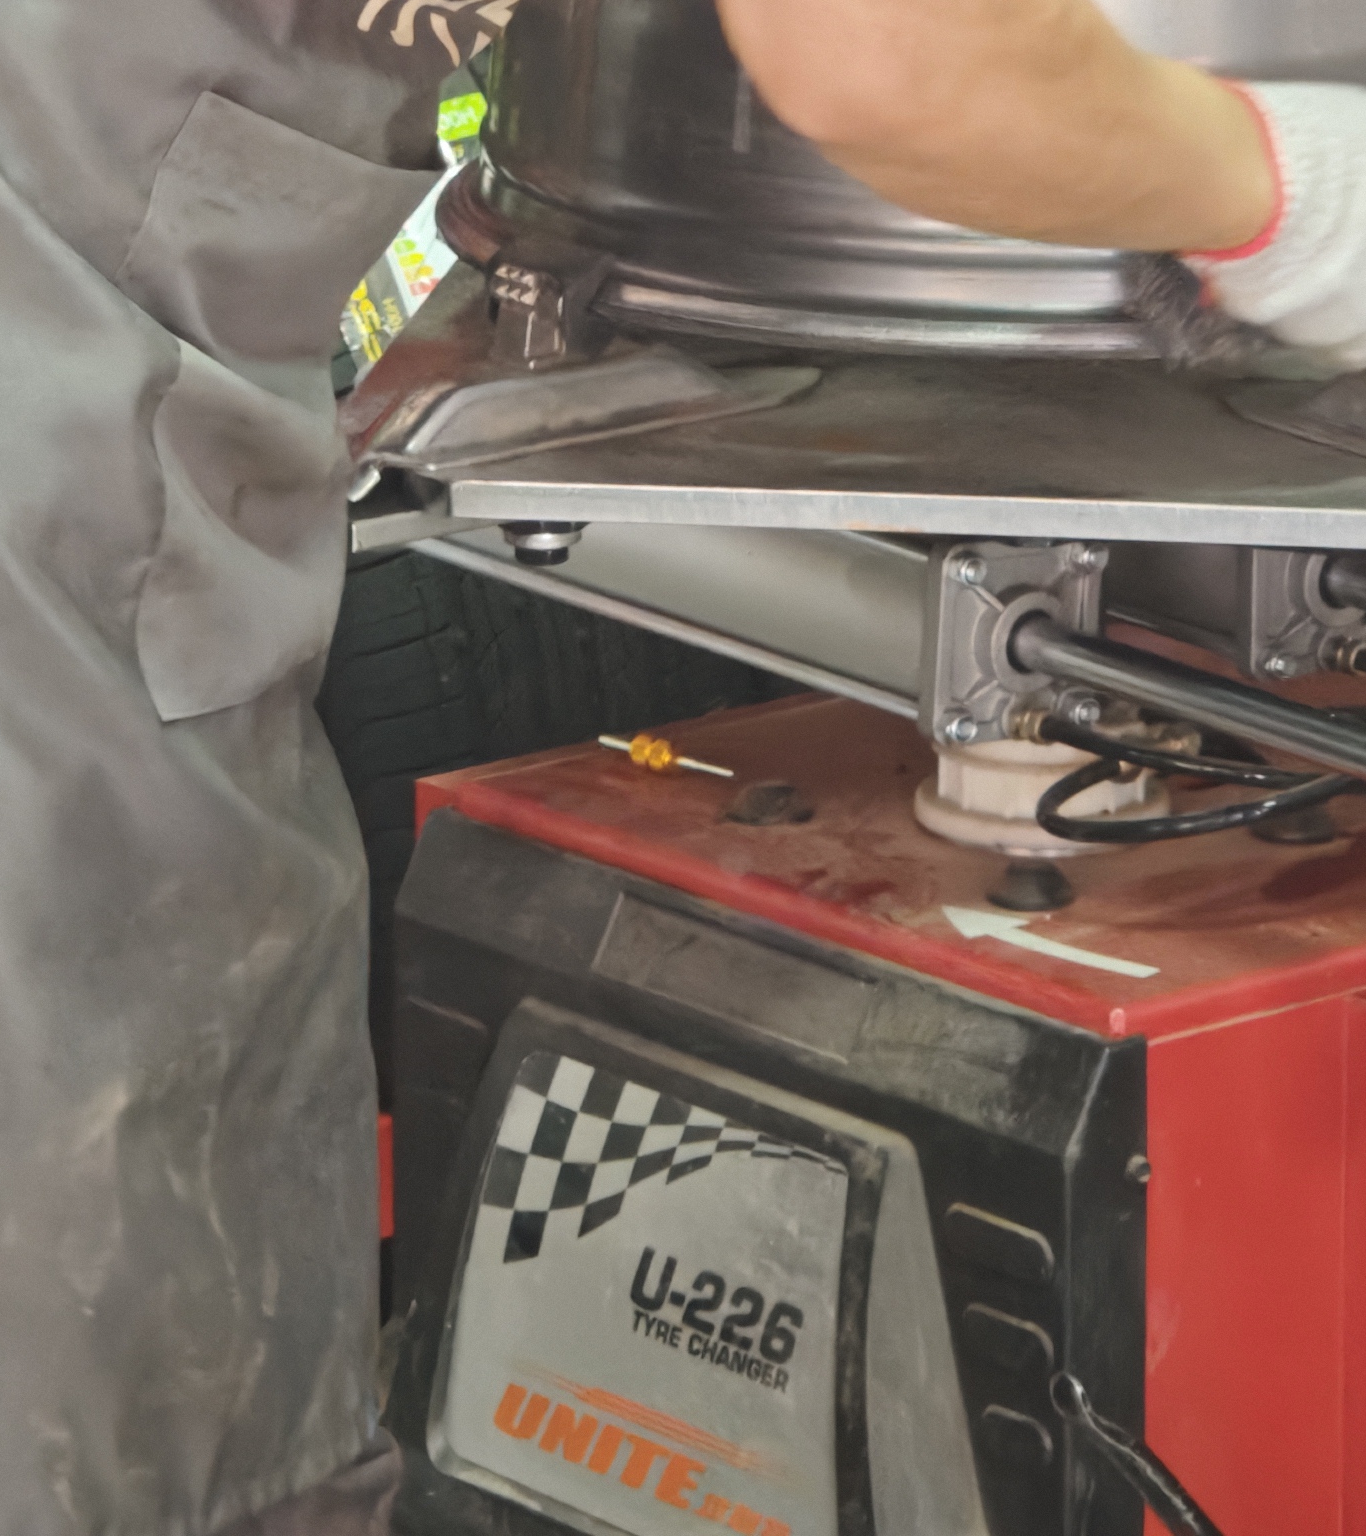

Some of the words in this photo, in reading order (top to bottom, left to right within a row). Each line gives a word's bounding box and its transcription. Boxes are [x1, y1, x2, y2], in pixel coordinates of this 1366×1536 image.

[629, 1245, 804, 1366] U-226
[631, 1310, 681, 1351] TYRE
[686, 1326, 791, 1395] CHANGER
[492, 1381, 707, 1508] UNITE
